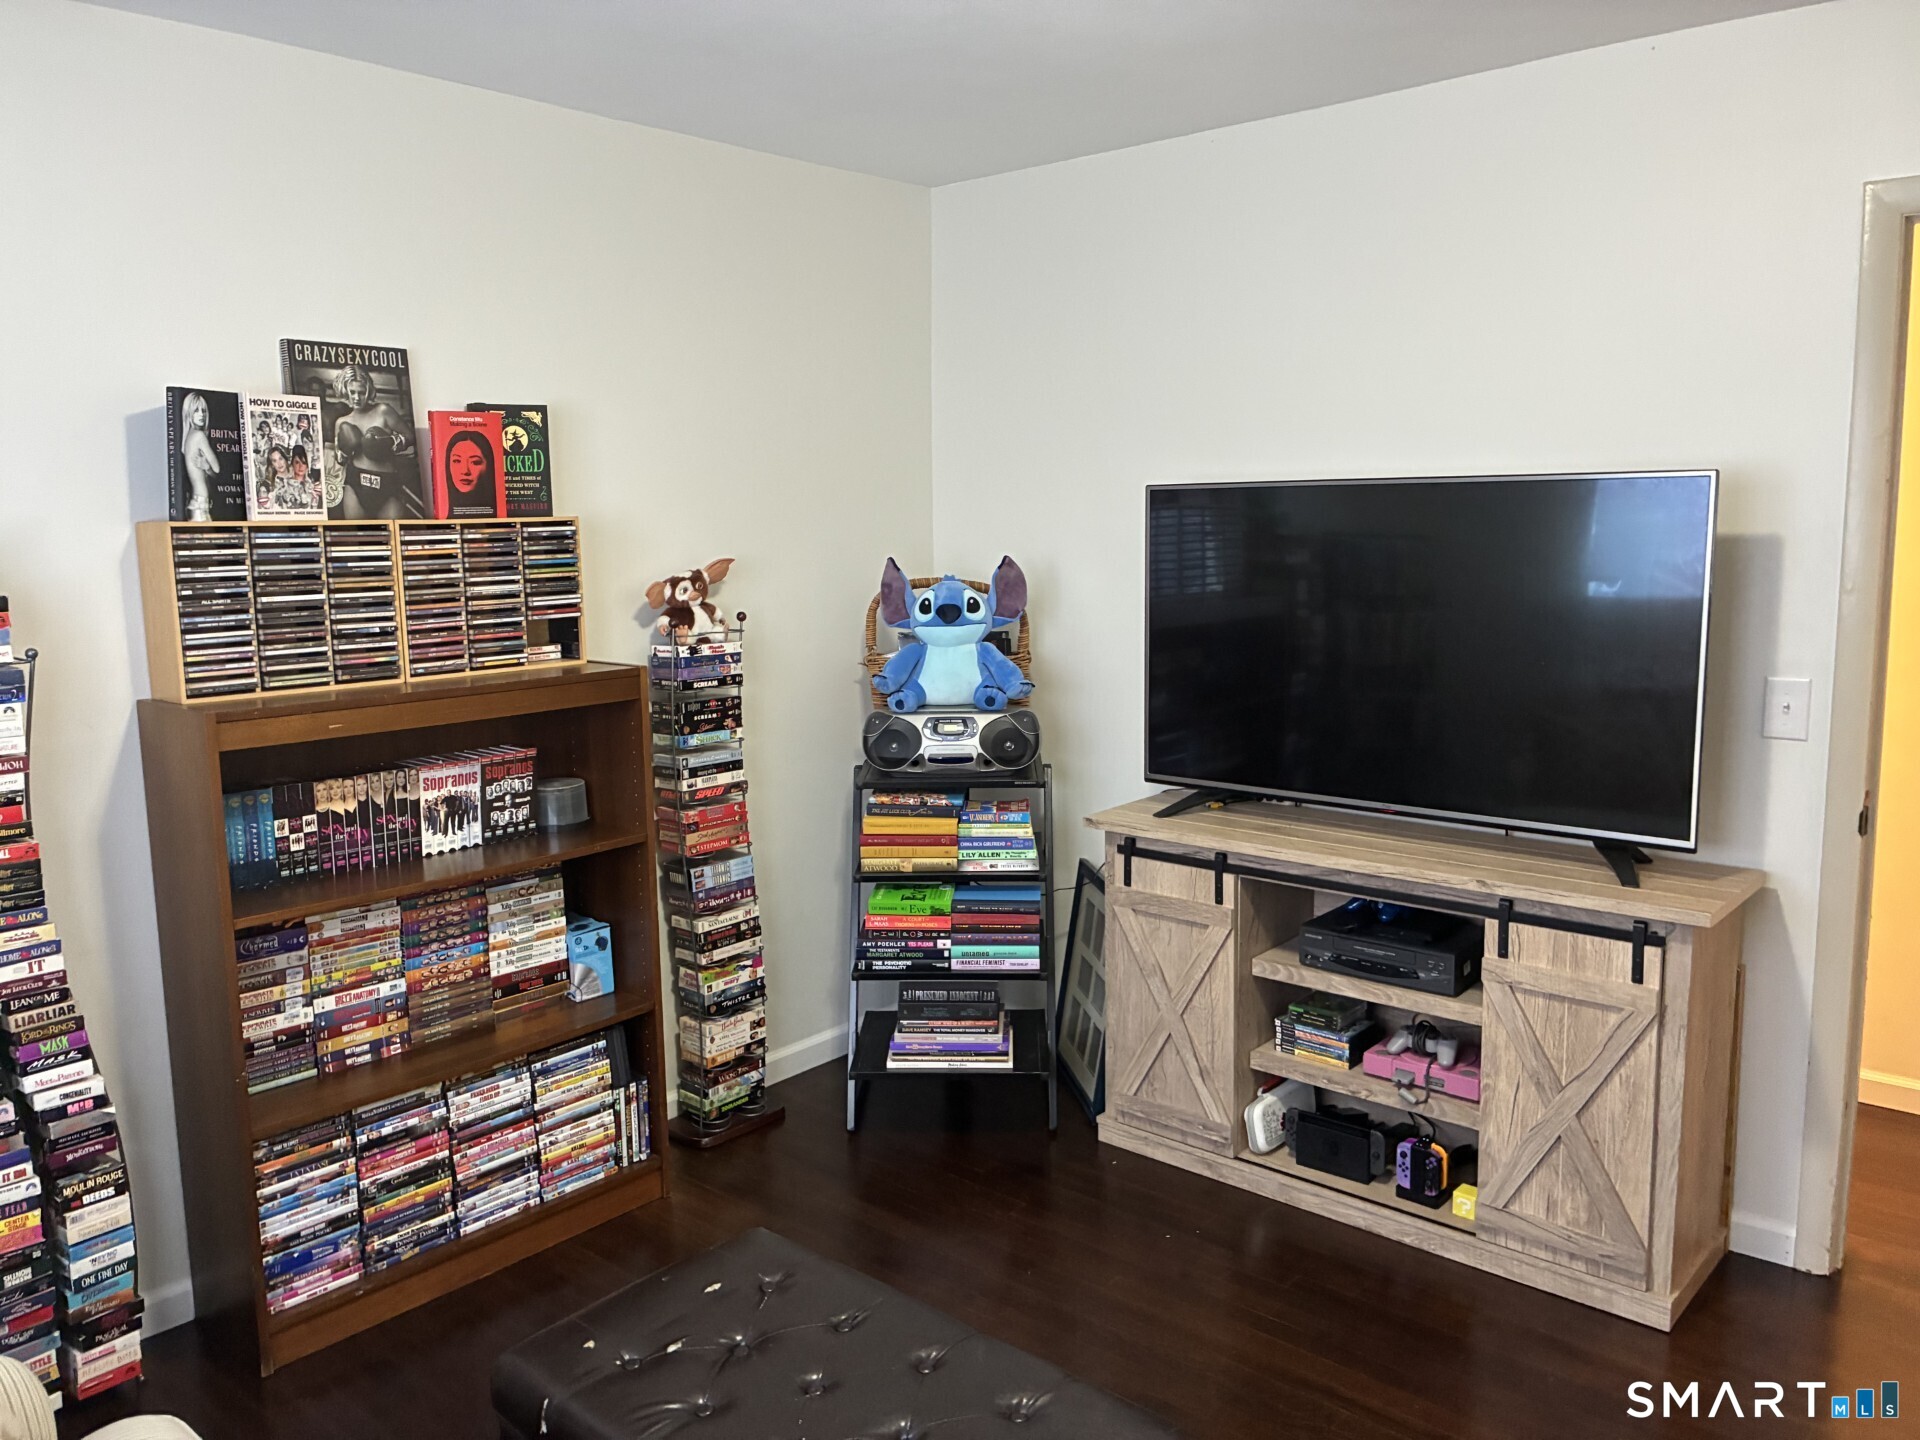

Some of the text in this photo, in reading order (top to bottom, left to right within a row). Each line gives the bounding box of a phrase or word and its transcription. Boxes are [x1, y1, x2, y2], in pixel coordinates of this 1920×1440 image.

[294, 343, 405, 368] CRAZYSEXYCOOL
[249, 398, 317, 410] HOW TO GIGGLE
[210, 428, 239, 439] BRITNE
[216, 444, 240, 452] SPEAR
[504, 448, 544, 473] ICKED
[693, 680, 718, 688] SCREAM
[695, 786, 725, 800] SPEED
[909, 905, 927, 914] Eve
[240, 935, 278, 955] Charmed
[28, 960, 45, 974] IT
[10, 998, 33, 1011] LEAN
[44, 991, 60, 1003] ME
[335, 988, 376, 1007] GREY'S ANATOMY
[722, 994, 751, 1008] TWISTER
[49, 1020, 76, 1034] RINGS
[39, 1035, 69, 1055] MASK
[27, 1050, 82, 1070] MASK
[59, 1087, 92, 1101] CONGENIALITY
[63, 1169, 124, 1197] MOULIN ROUGE
[82, 1186, 116, 1205] DEEDS
[4, 1215, 29, 1228] CENTER
[81, 1261, 128, 1288] ONE FINE DAY
